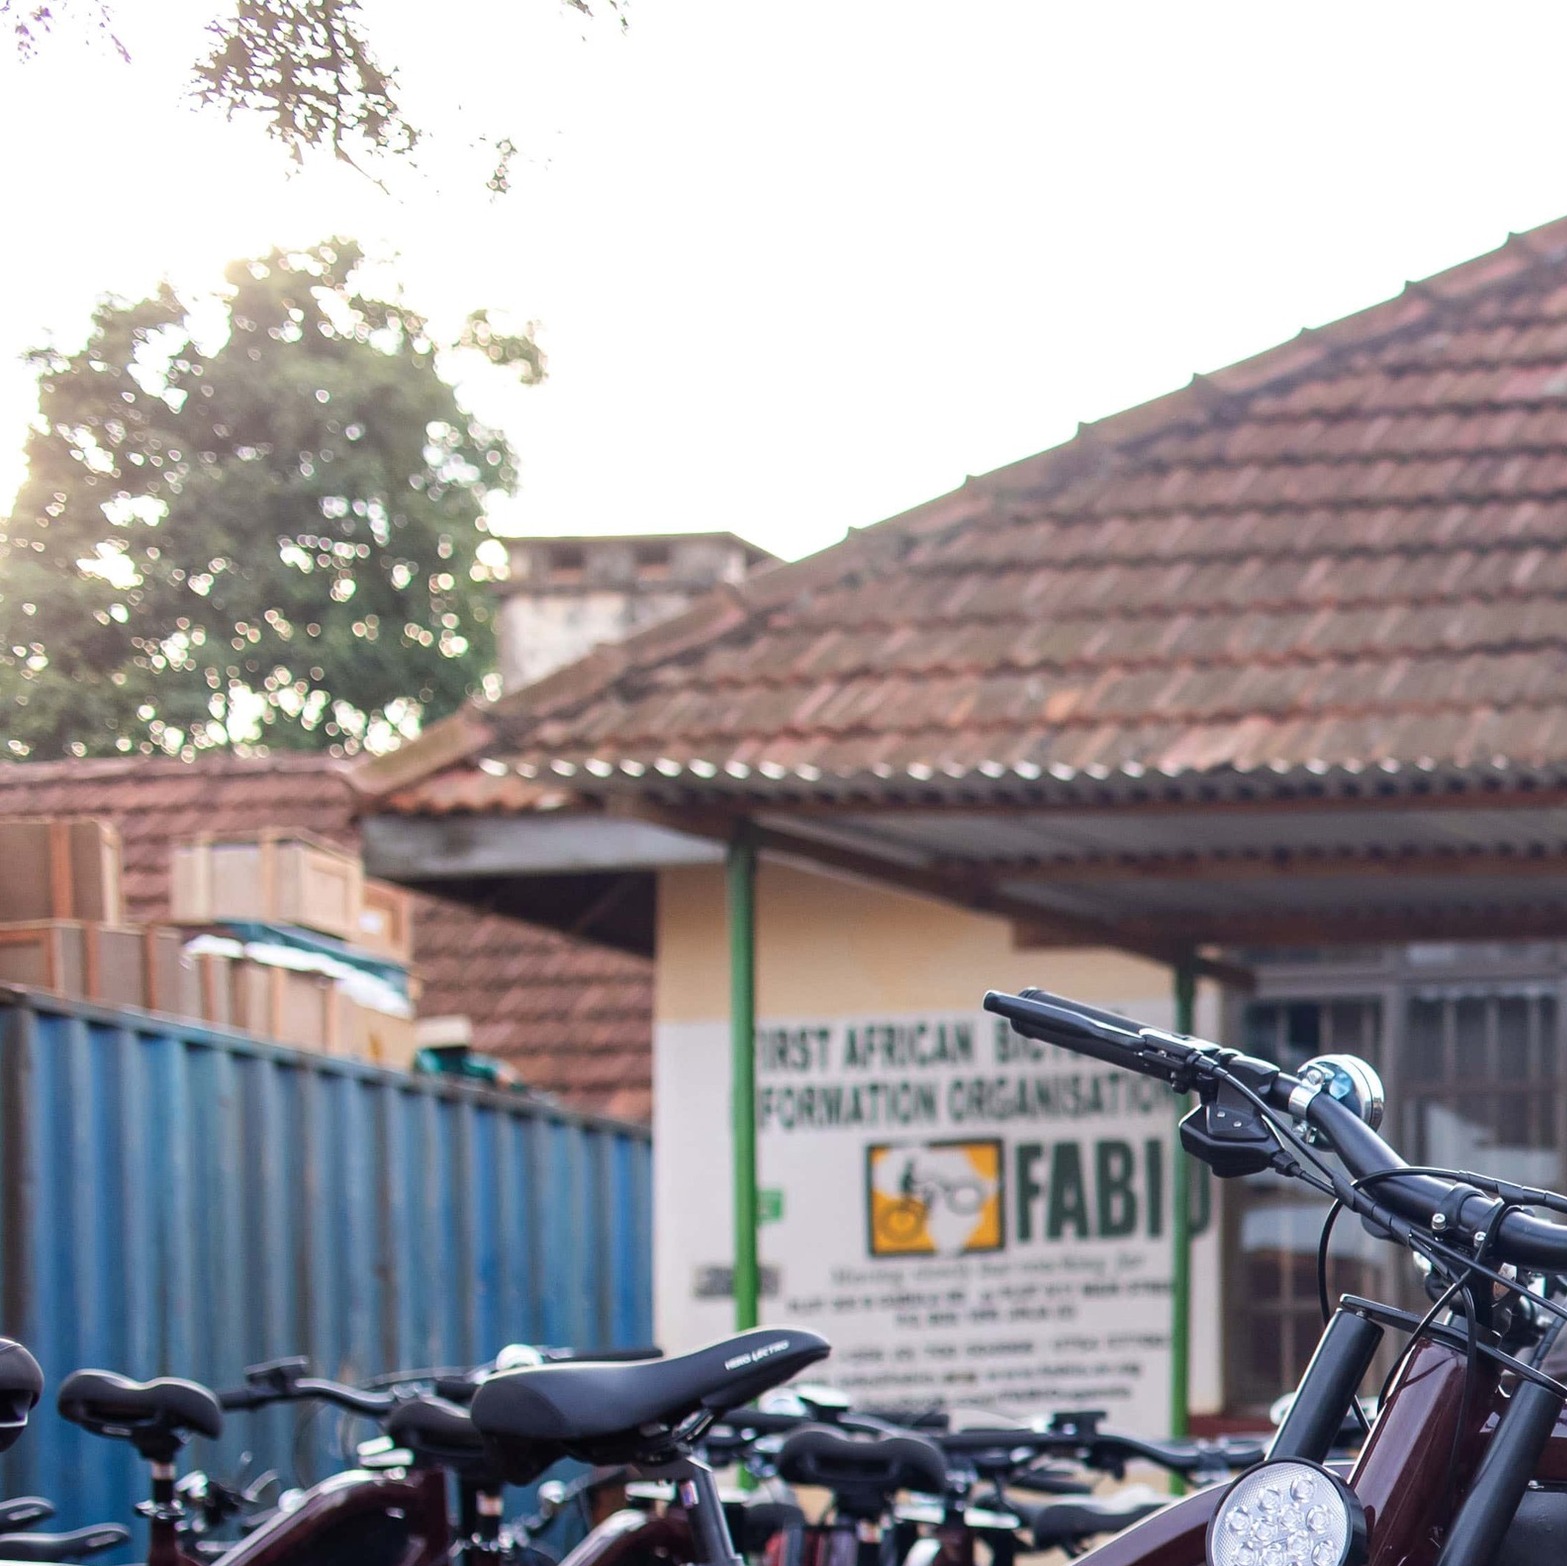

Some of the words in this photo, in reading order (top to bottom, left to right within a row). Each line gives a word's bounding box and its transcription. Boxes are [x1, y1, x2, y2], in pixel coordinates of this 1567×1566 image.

[760, 1022, 831, 1071] IRST
[843, 1017, 975, 1070] AFRICAN
[760, 1078, 938, 1131] FORMATION
